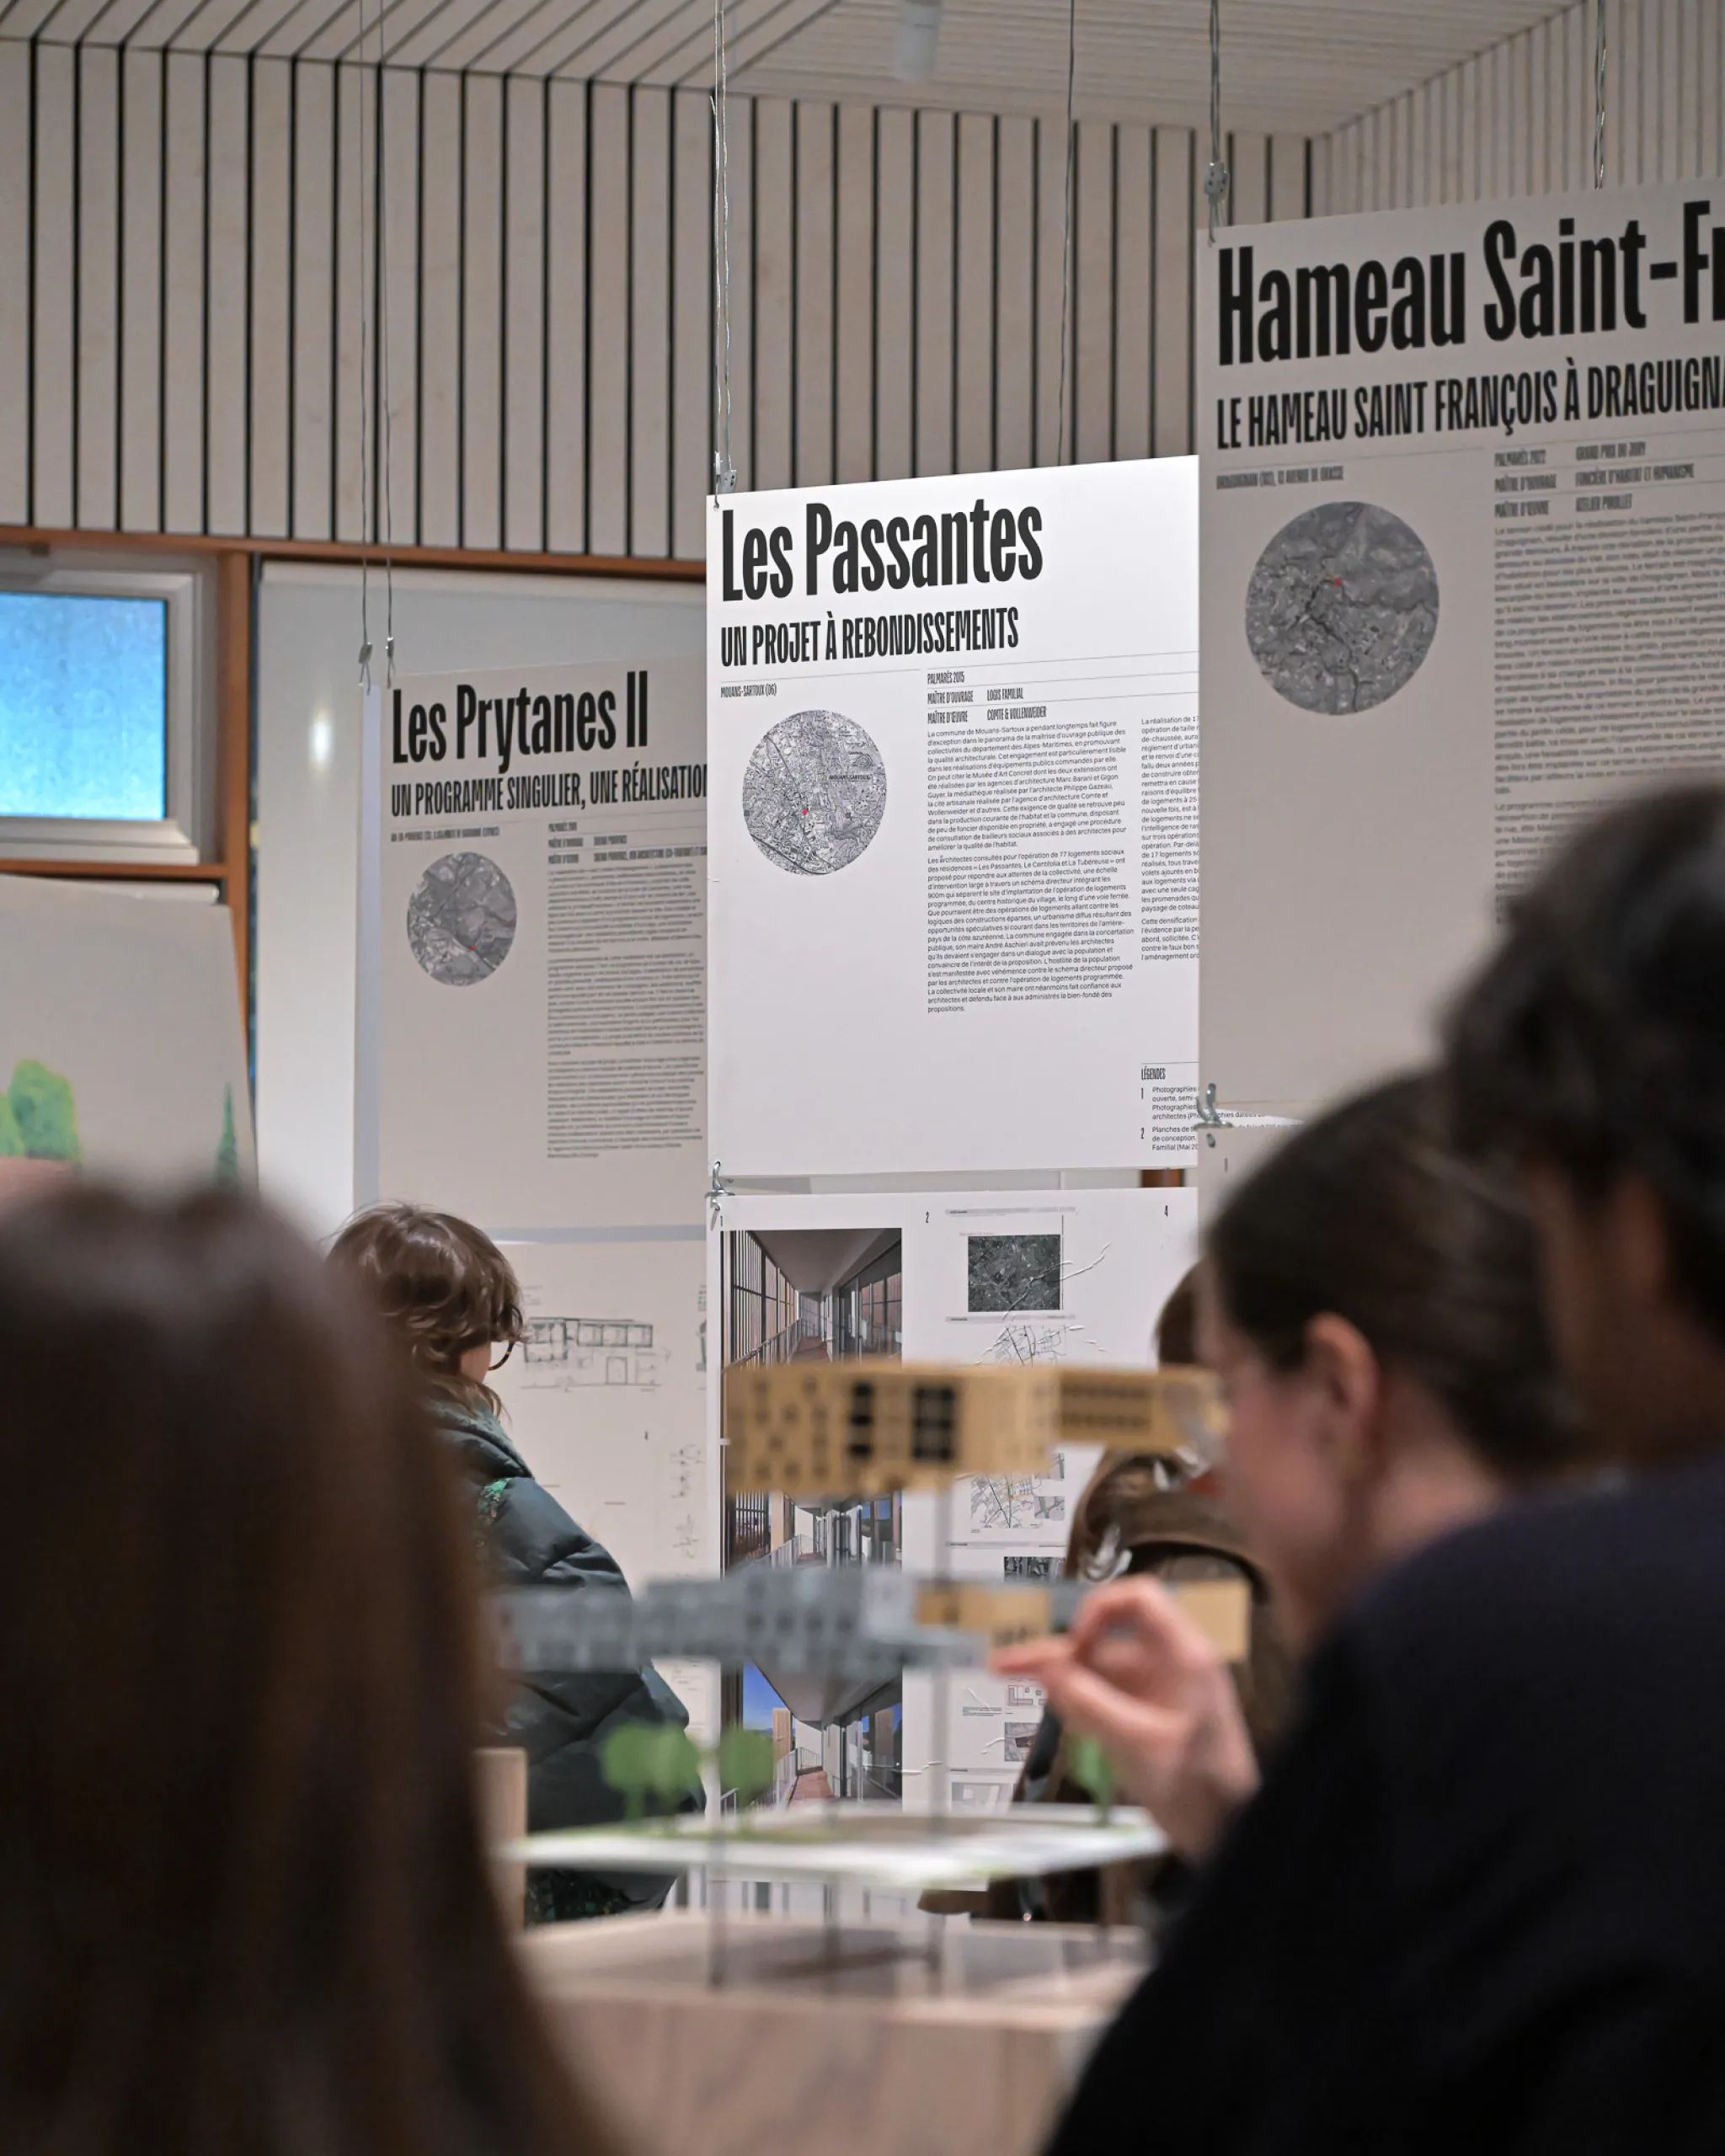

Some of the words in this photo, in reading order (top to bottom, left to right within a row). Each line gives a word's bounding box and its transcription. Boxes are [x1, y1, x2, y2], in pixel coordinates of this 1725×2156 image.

[1220, 246, 1465, 366] Hameau
[1218, 398, 1241, 449] LE
[1249, 389, 1346, 446] HAMEAU
[1354, 382, 1428, 438] SAINT
[1436, 371, 1557, 435] FRANÇOIS
[1565, 357, 1579, 420] À
[1589, 356, 1725, 419] DRAGUIGN
[723, 510, 793, 601] Les
[807, 499, 1043, 595] Passantes
[722, 627, 746, 666] UN
[753, 621, 820, 664] PROJET
[825, 611, 836, 659] À
[843, 607, 1018, 659] REBONDISSEMENTS
[927, 670, 953, 686] PALMARÈS
[953, 670, 964, 684] 2015
[721, 684, 765, 698] MOUANS-SARTOUX
[766, 682, 777, 696] (06)
[927, 690, 945, 705] MAÎTRE
[946, 691, 974, 703] D'OUVRAGE
[987, 689, 1001, 702] LOGIS
[1002, 687, 1023, 700] FAMILIAL
[393, 690, 446, 763] Les
[457, 685, 617, 774] Prytanes
[628, 670, 647, 747] II
[927, 709, 945, 724] MAÎTRE
[393, 784, 411, 816] UN
[416, 778, 503, 815] PROGRAMME
[508, 771, 585, 809] SINGULIER,
[590, 771, 617, 804] UNE
[1141, 1066, 1167, 1081] LÉGENDES
[1140, 1087, 1144, 1100] 1
[1140, 1127, 1145, 1139] 2
